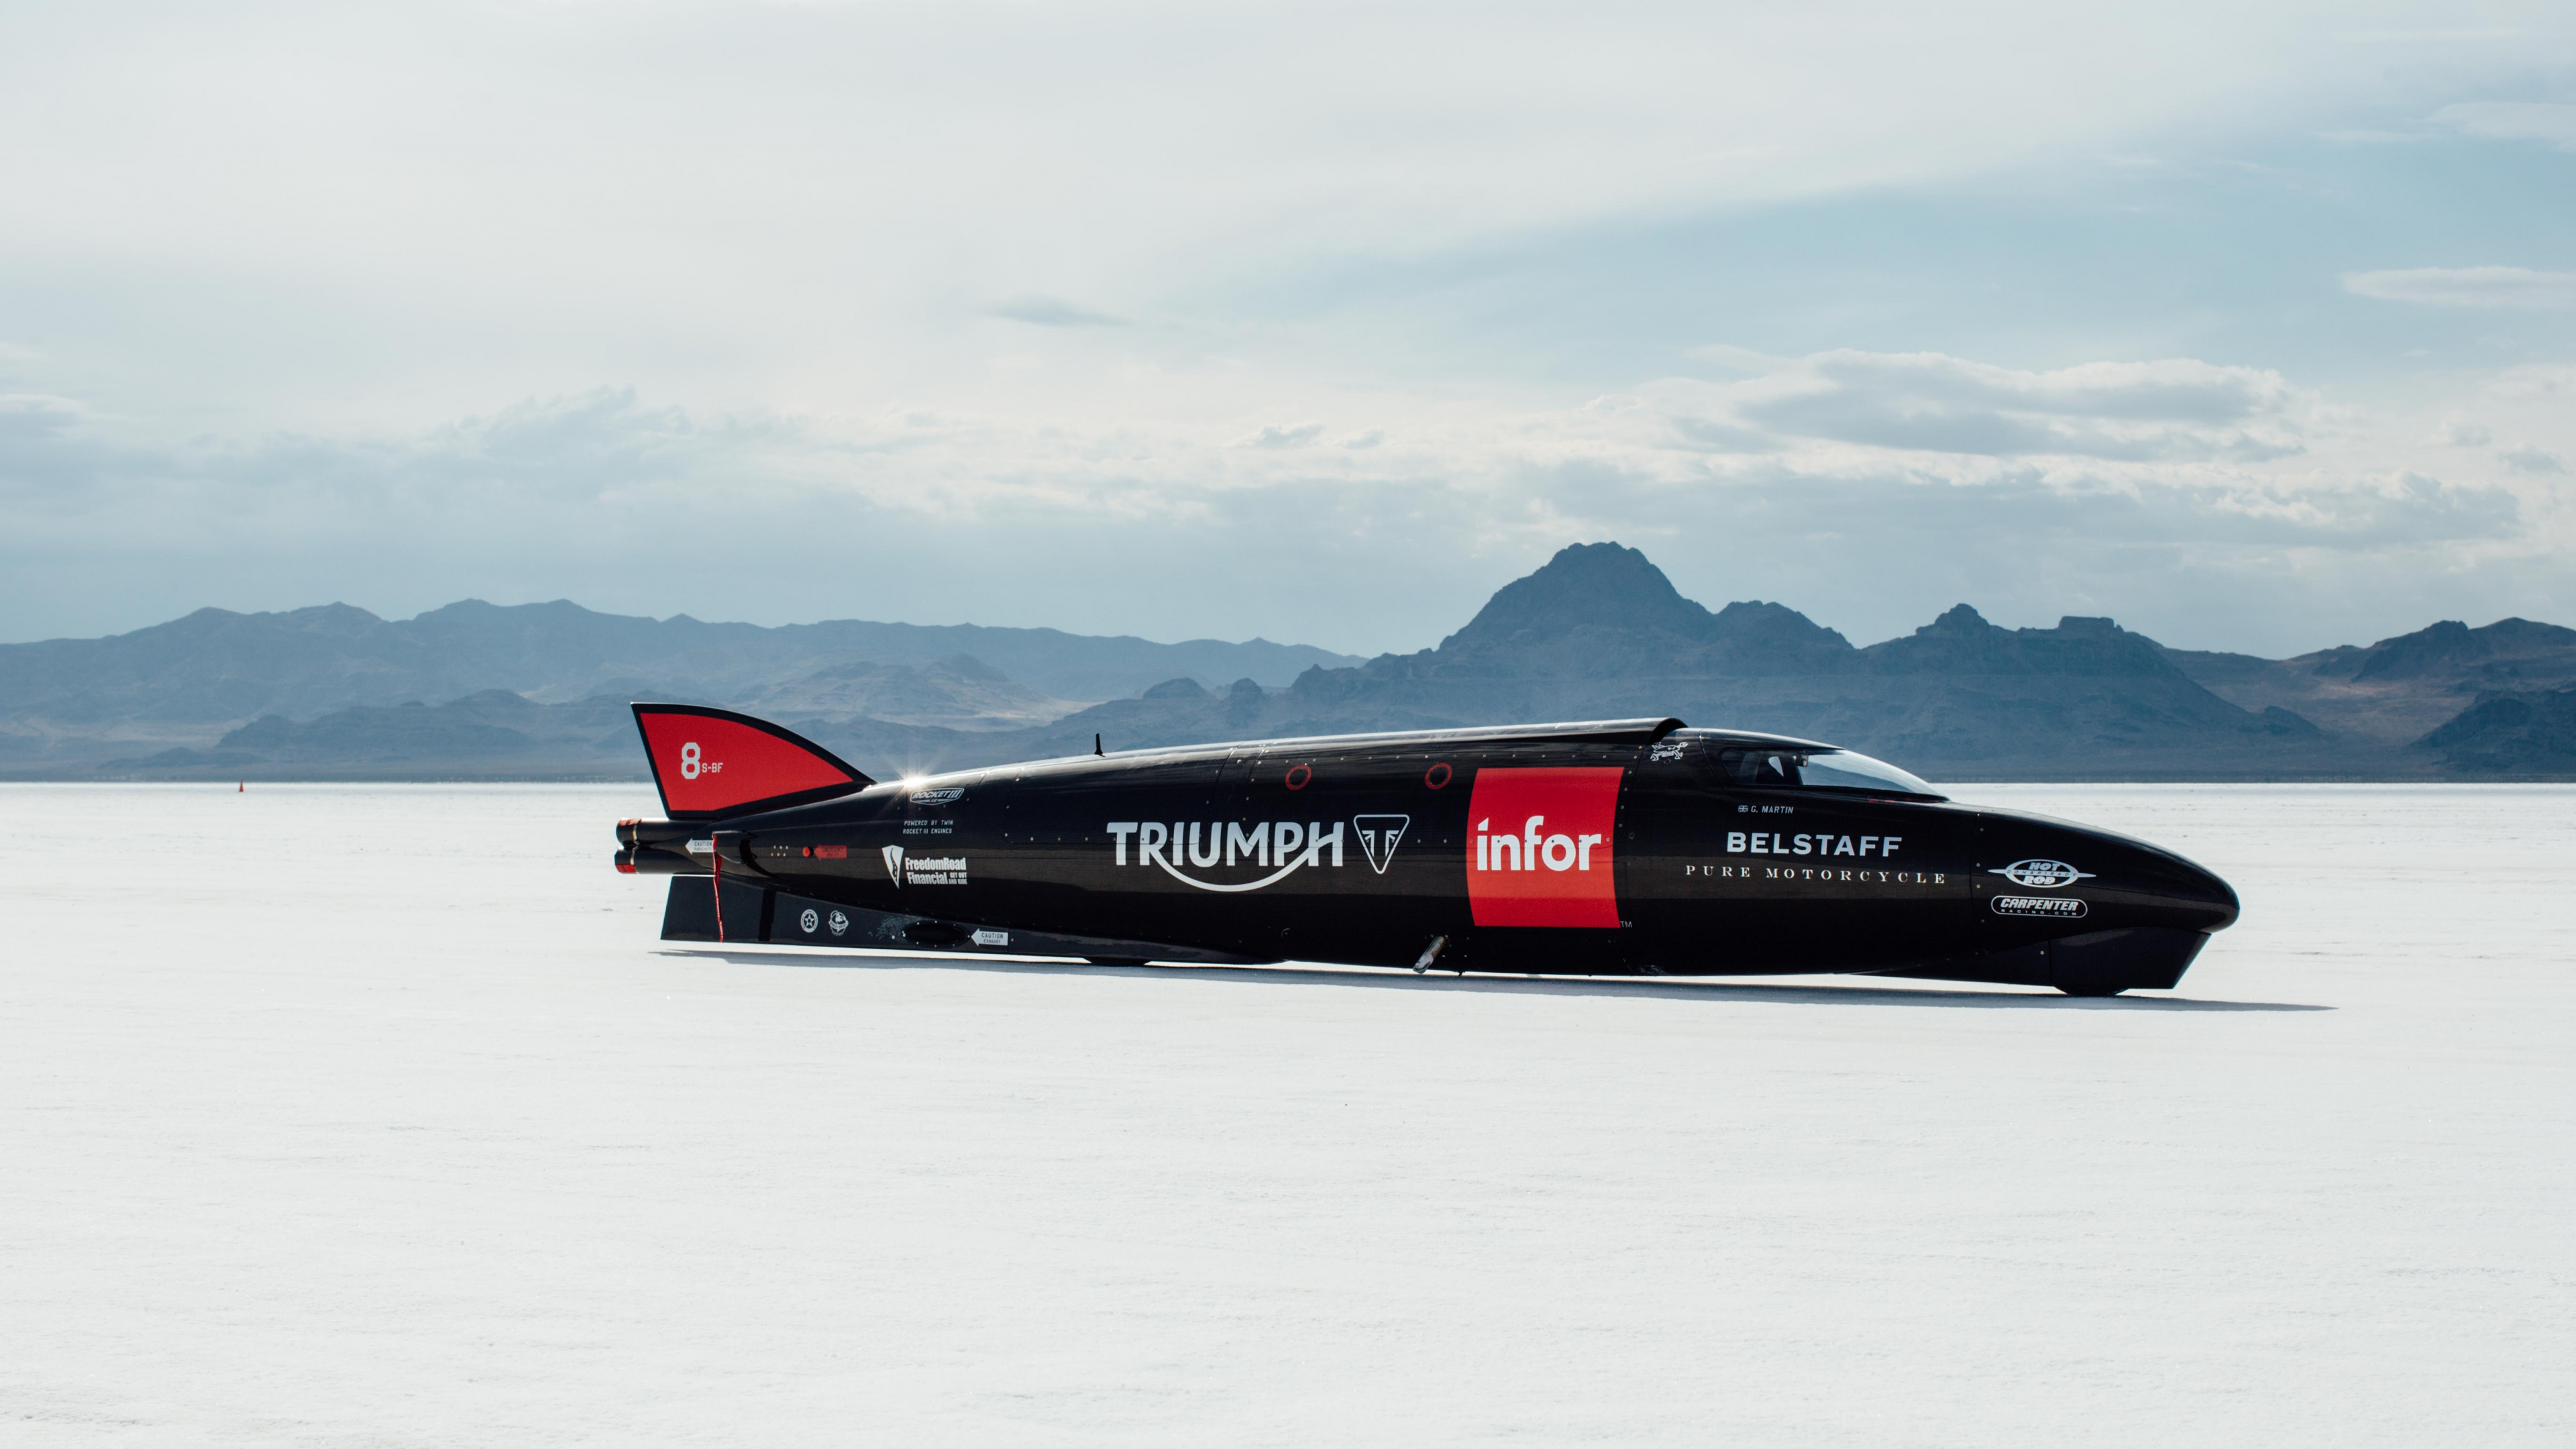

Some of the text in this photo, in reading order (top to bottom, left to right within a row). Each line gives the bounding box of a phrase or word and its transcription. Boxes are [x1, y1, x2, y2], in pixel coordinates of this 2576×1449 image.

[681, 742, 723, 779] 8 S-BF
[947, 790, 962, 798] III
[1762, 806, 1794, 814] MARTIN
[1477, 816, 1601, 871] infor
[1727, 832, 1902, 857] BELSTAFF
[905, 857, 967, 870] FreedomRoad
[1106, 822, 1344, 892] TRIUMPH
[2006, 869, 2078, 877] CONSPIRACY
[2029, 862, 2060, 871] HOT
[907, 871, 948, 884] Financial
[1686, 865, 1945, 883] PURE MOTORCYCLE
[2023, 875, 2056, 885] ROD
[2000, 898, 2078, 911] CARPENTER
